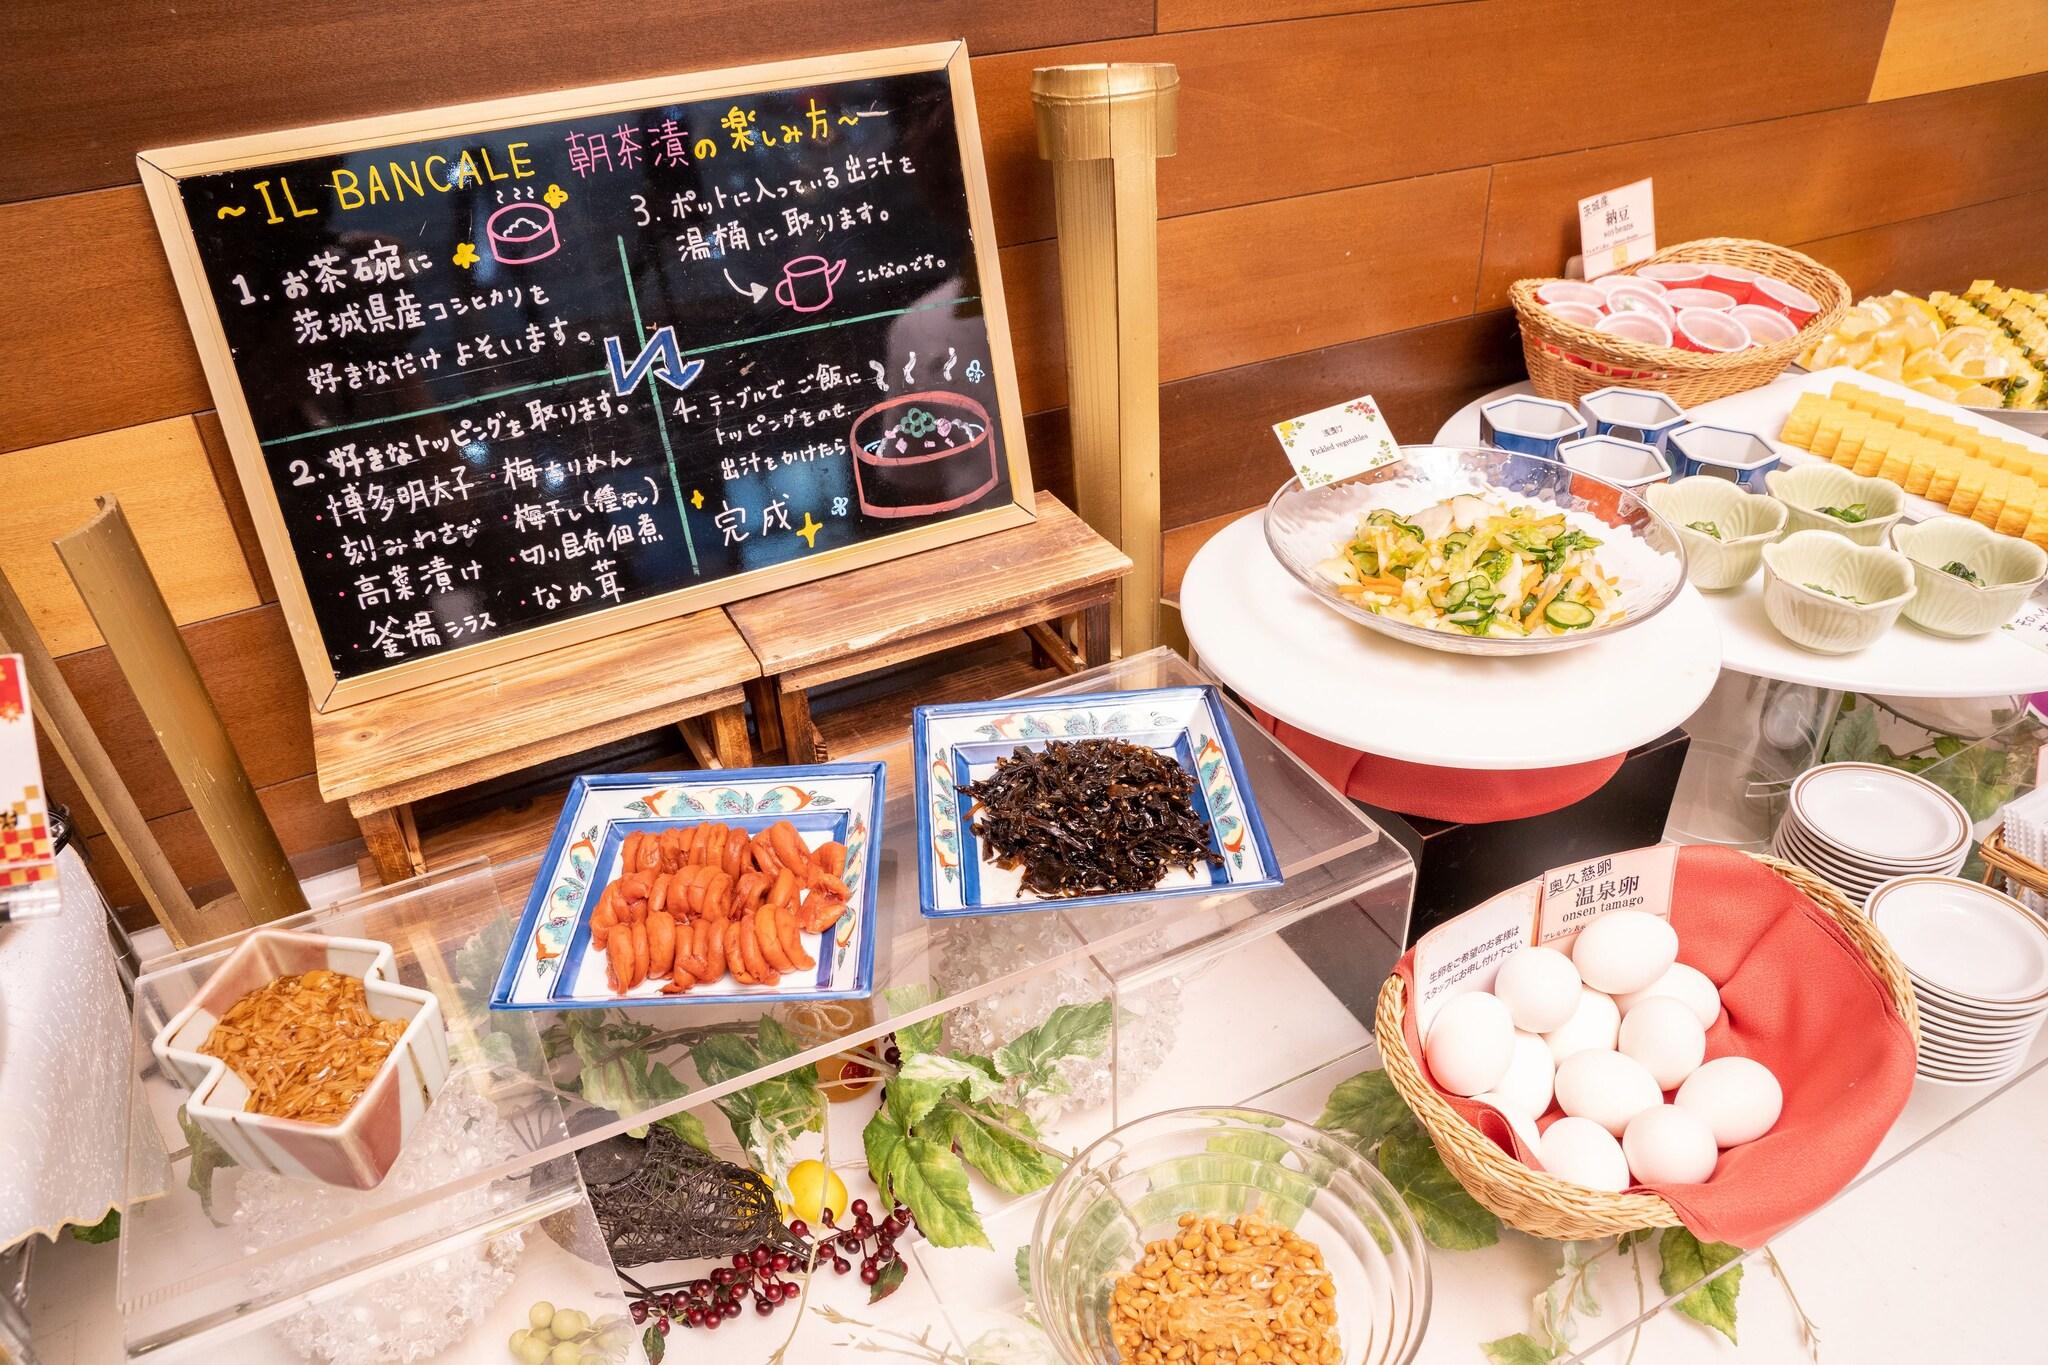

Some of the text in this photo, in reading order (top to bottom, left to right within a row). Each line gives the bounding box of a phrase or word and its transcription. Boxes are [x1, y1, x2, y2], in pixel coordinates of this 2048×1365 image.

[331, 142, 535, 210] BANCALE
[1605, 205, 1630, 226] 納豆
[282, 239, 433, 299] お茶碗に
[720, 438, 848, 480] 出汁をかけたら
[1310, 433, 1369, 456] Pickled vegetables
[714, 493, 791, 546] 完成
[1549, 858, 1612, 897] 奥久慈卵
[1575, 875, 1640, 908] 温泉卵
[1562, 895, 1644, 922] onsen tamago
[1424, 939, 1523, 1004] スタッフにお申し付け下さい
[1429, 925, 1520, 984] 生卵をご希望のお客様は
